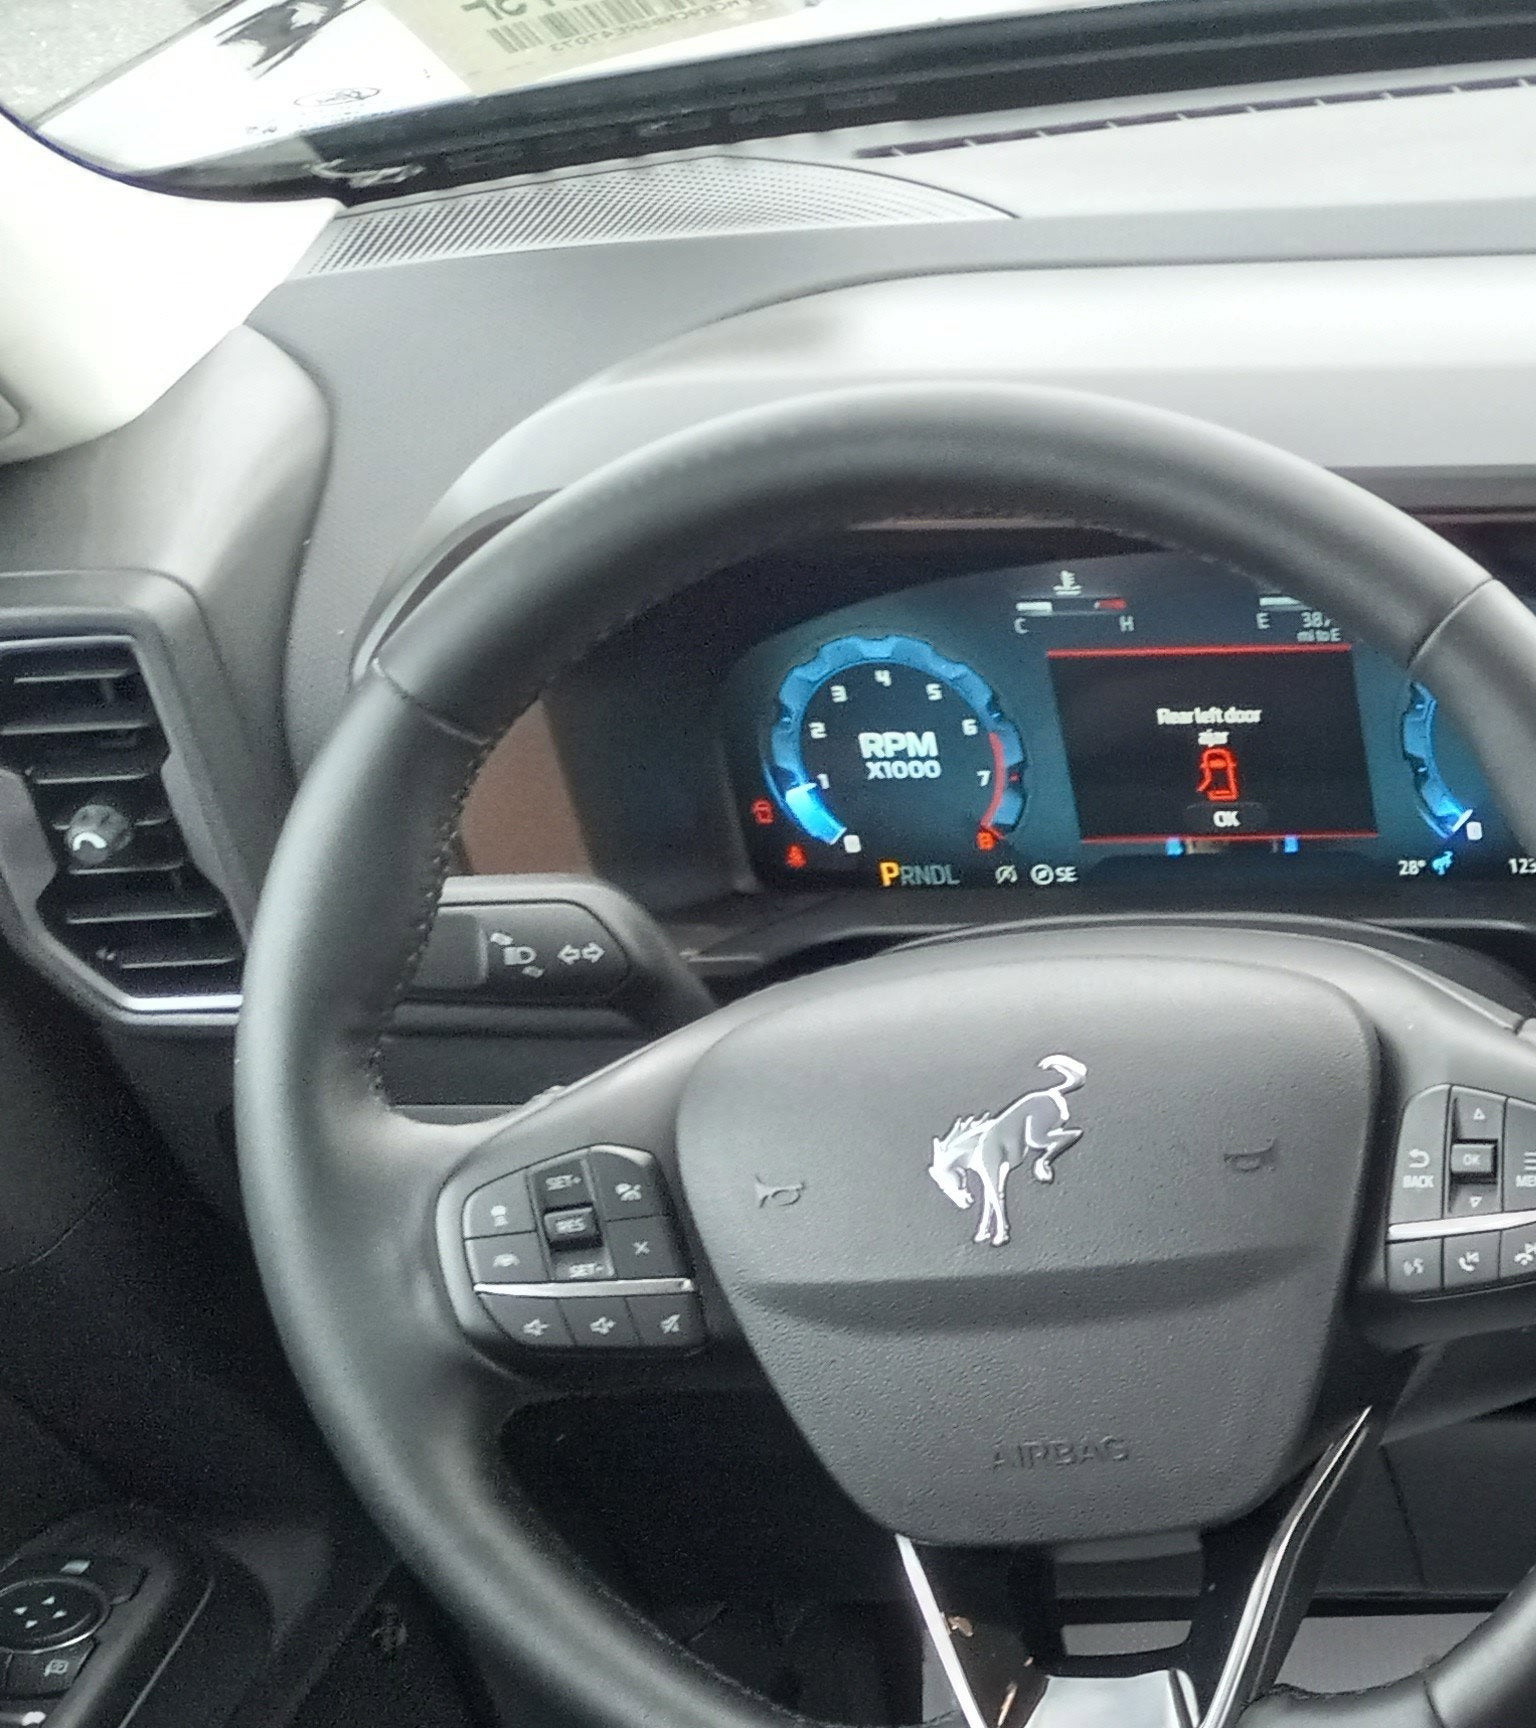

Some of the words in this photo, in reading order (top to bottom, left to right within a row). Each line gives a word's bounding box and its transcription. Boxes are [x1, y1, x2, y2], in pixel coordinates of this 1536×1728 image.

[1014, 617, 1029, 634] C
[1119, 615, 1135, 632] H
[1256, 612, 1271, 629] E
[874, 669, 892, 687] 4
[830, 685, 848, 703] 3
[925, 683, 943, 700] 5
[1156, 707, 1195, 725] Rear
[1194, 706, 1224, 724] left
[1223, 706, 1262, 724] door
[808, 722, 828, 739] 2
[961, 718, 979, 735] 6
[858, 731, 939, 759] RPM
[817, 773, 830, 790] 1
[976, 770, 991, 787] 7
[1212, 810, 1241, 828] OK
[1462, 1153, 1481, 1167] OK
[1403, 1174, 1434, 1189] BACK
